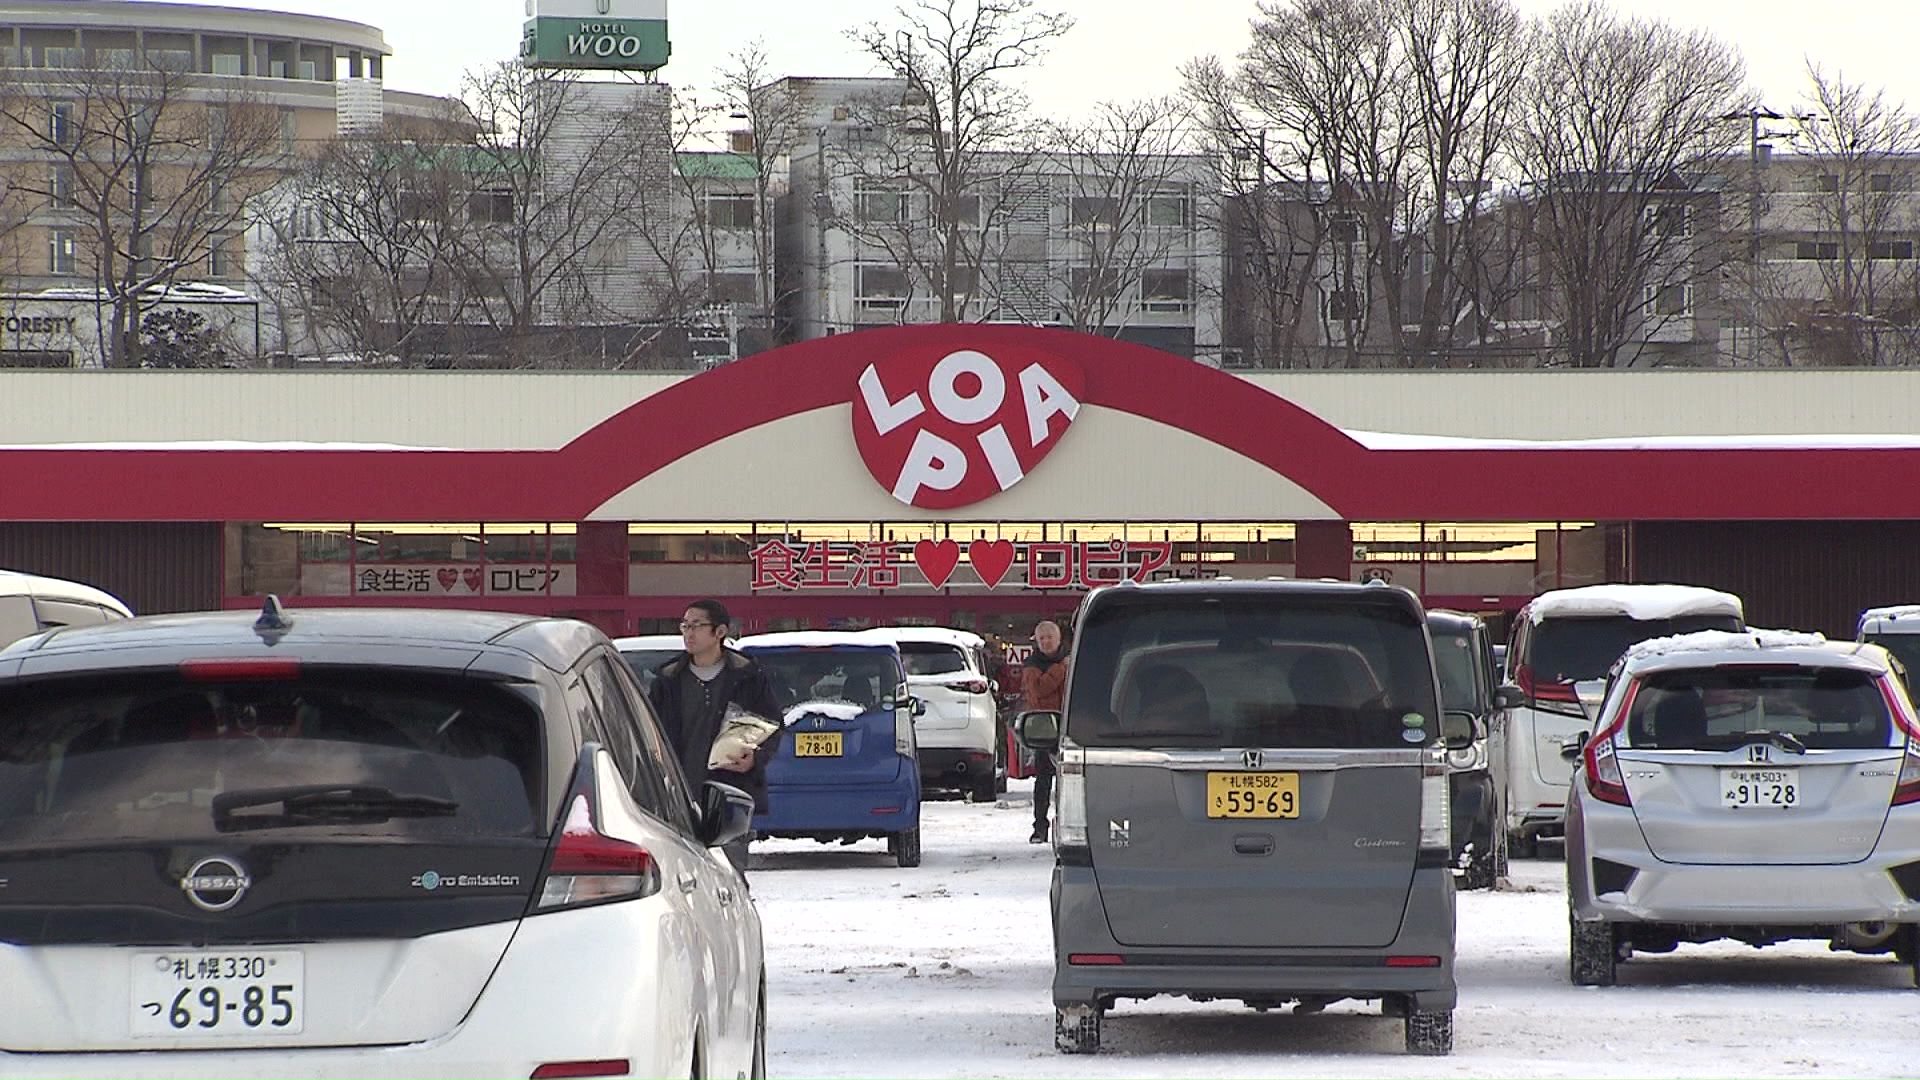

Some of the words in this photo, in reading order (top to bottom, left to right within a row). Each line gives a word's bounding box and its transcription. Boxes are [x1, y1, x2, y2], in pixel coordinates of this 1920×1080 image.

[580, 23, 626, 34] HOTEL
[567, 34, 641, 57] WOO
[748, 538, 900, 590] 食生活
[1026, 539, 1173, 590] ロピア
[358, 568, 431, 592] 食生活
[491, 568, 560, 592] ロピア
[806, 742, 838, 754] 78-01
[1227, 791, 1294, 813] 59-69
[1738, 785, 1796, 804] 91-28
[180, 877, 250, 889] NISSAN
[141, 1002, 162, 1016] つ
[169, 985, 294, 1029] 69-85
